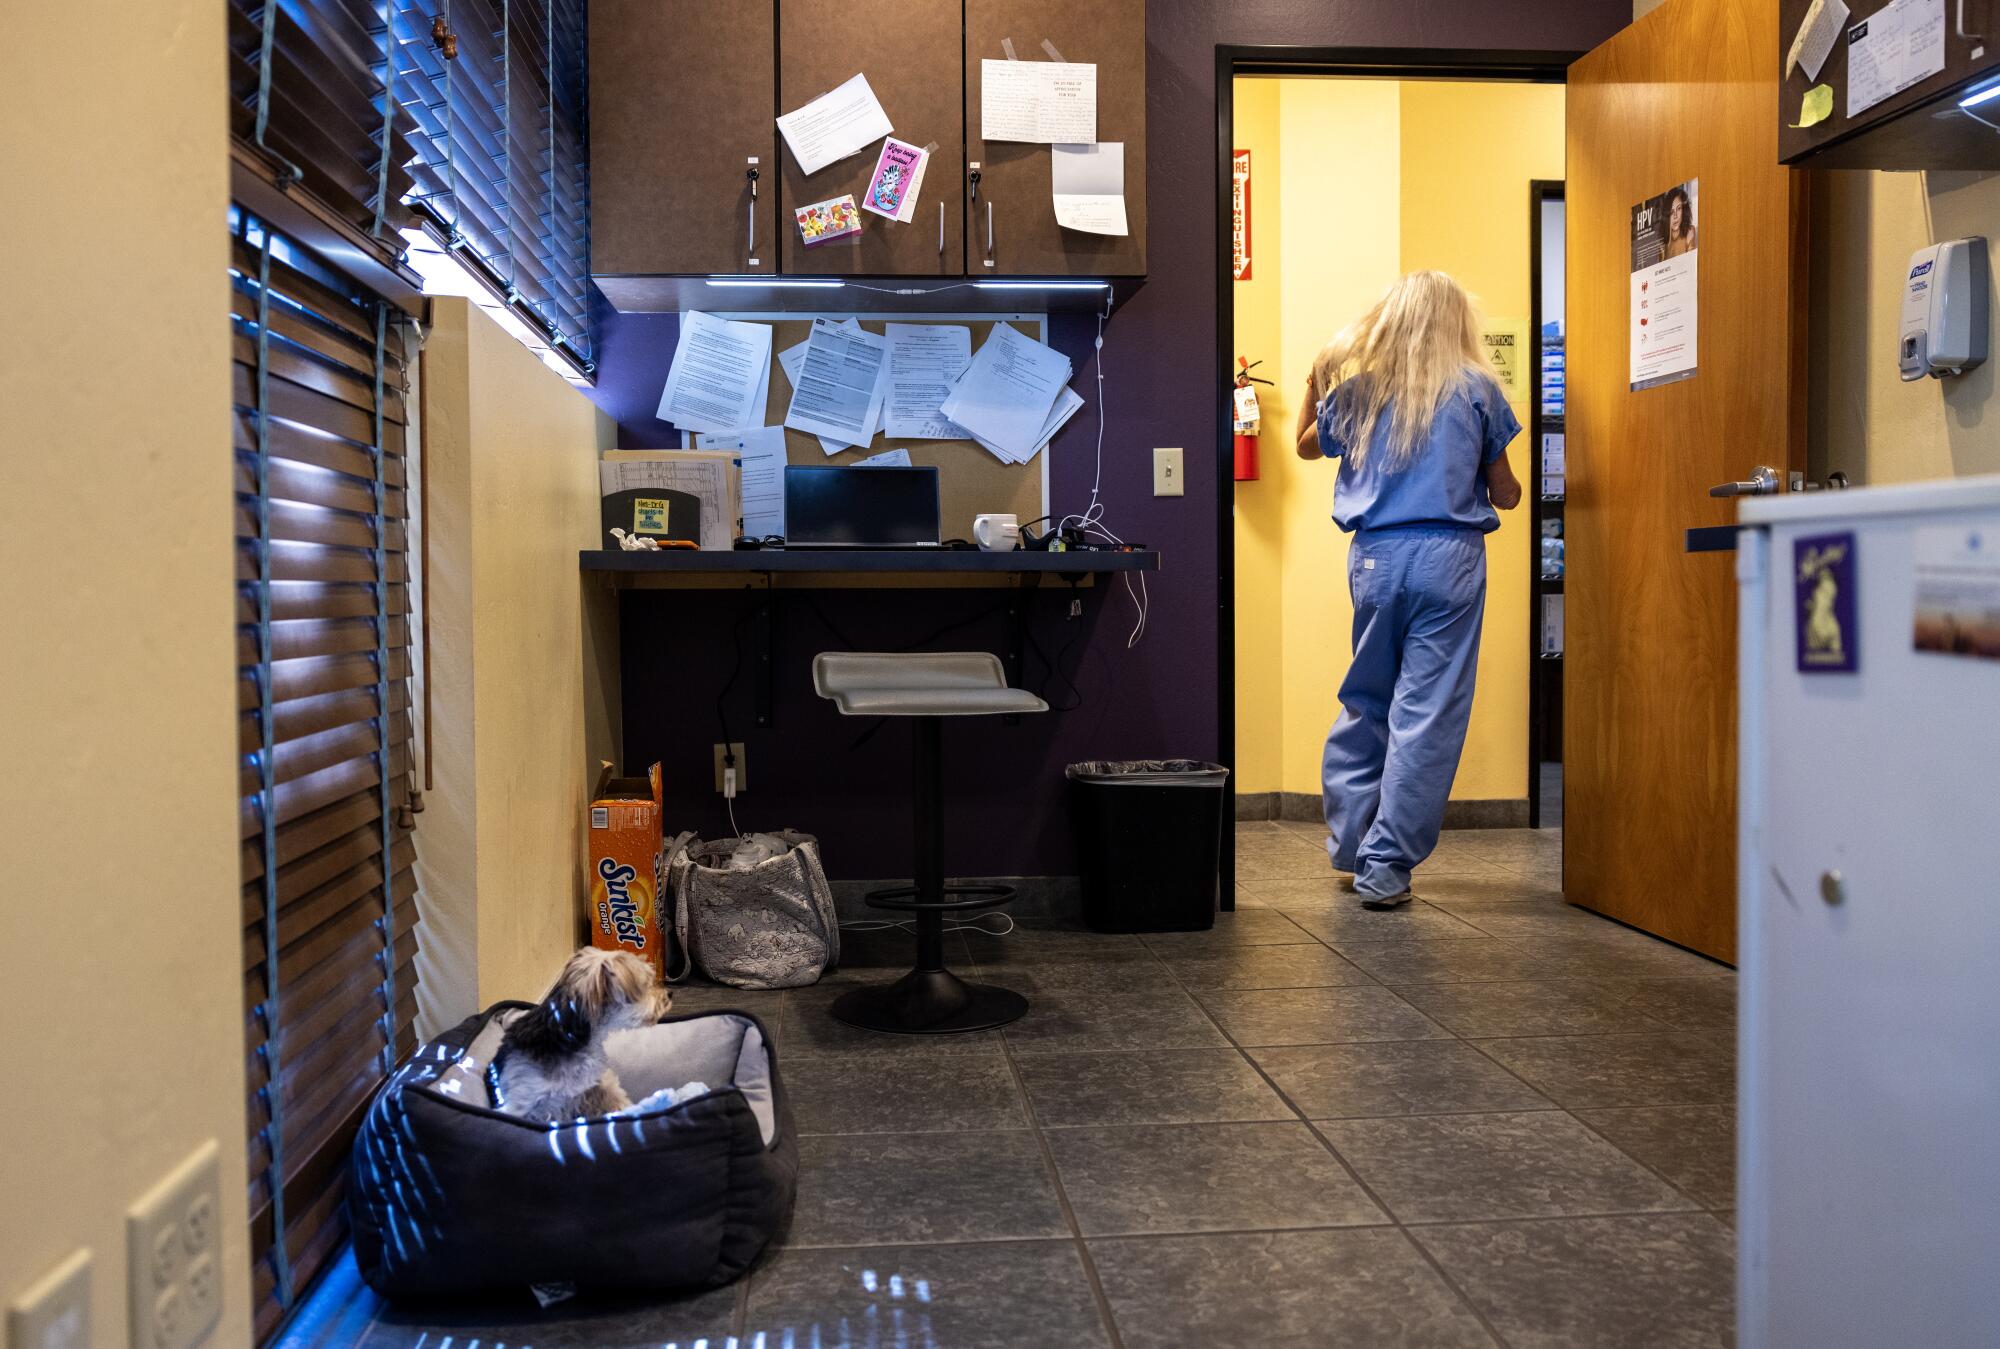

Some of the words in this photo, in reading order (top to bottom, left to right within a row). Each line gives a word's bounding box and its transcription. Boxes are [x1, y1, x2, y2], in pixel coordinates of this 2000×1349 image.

[888, 143, 903, 154] Keep
[1234, 161, 1247, 174] RE
[1233, 178, 1242, 271] EXTINGUISHER
[1637, 207, 1653, 231] HPV
[598, 857, 647, 950] Sunkist
